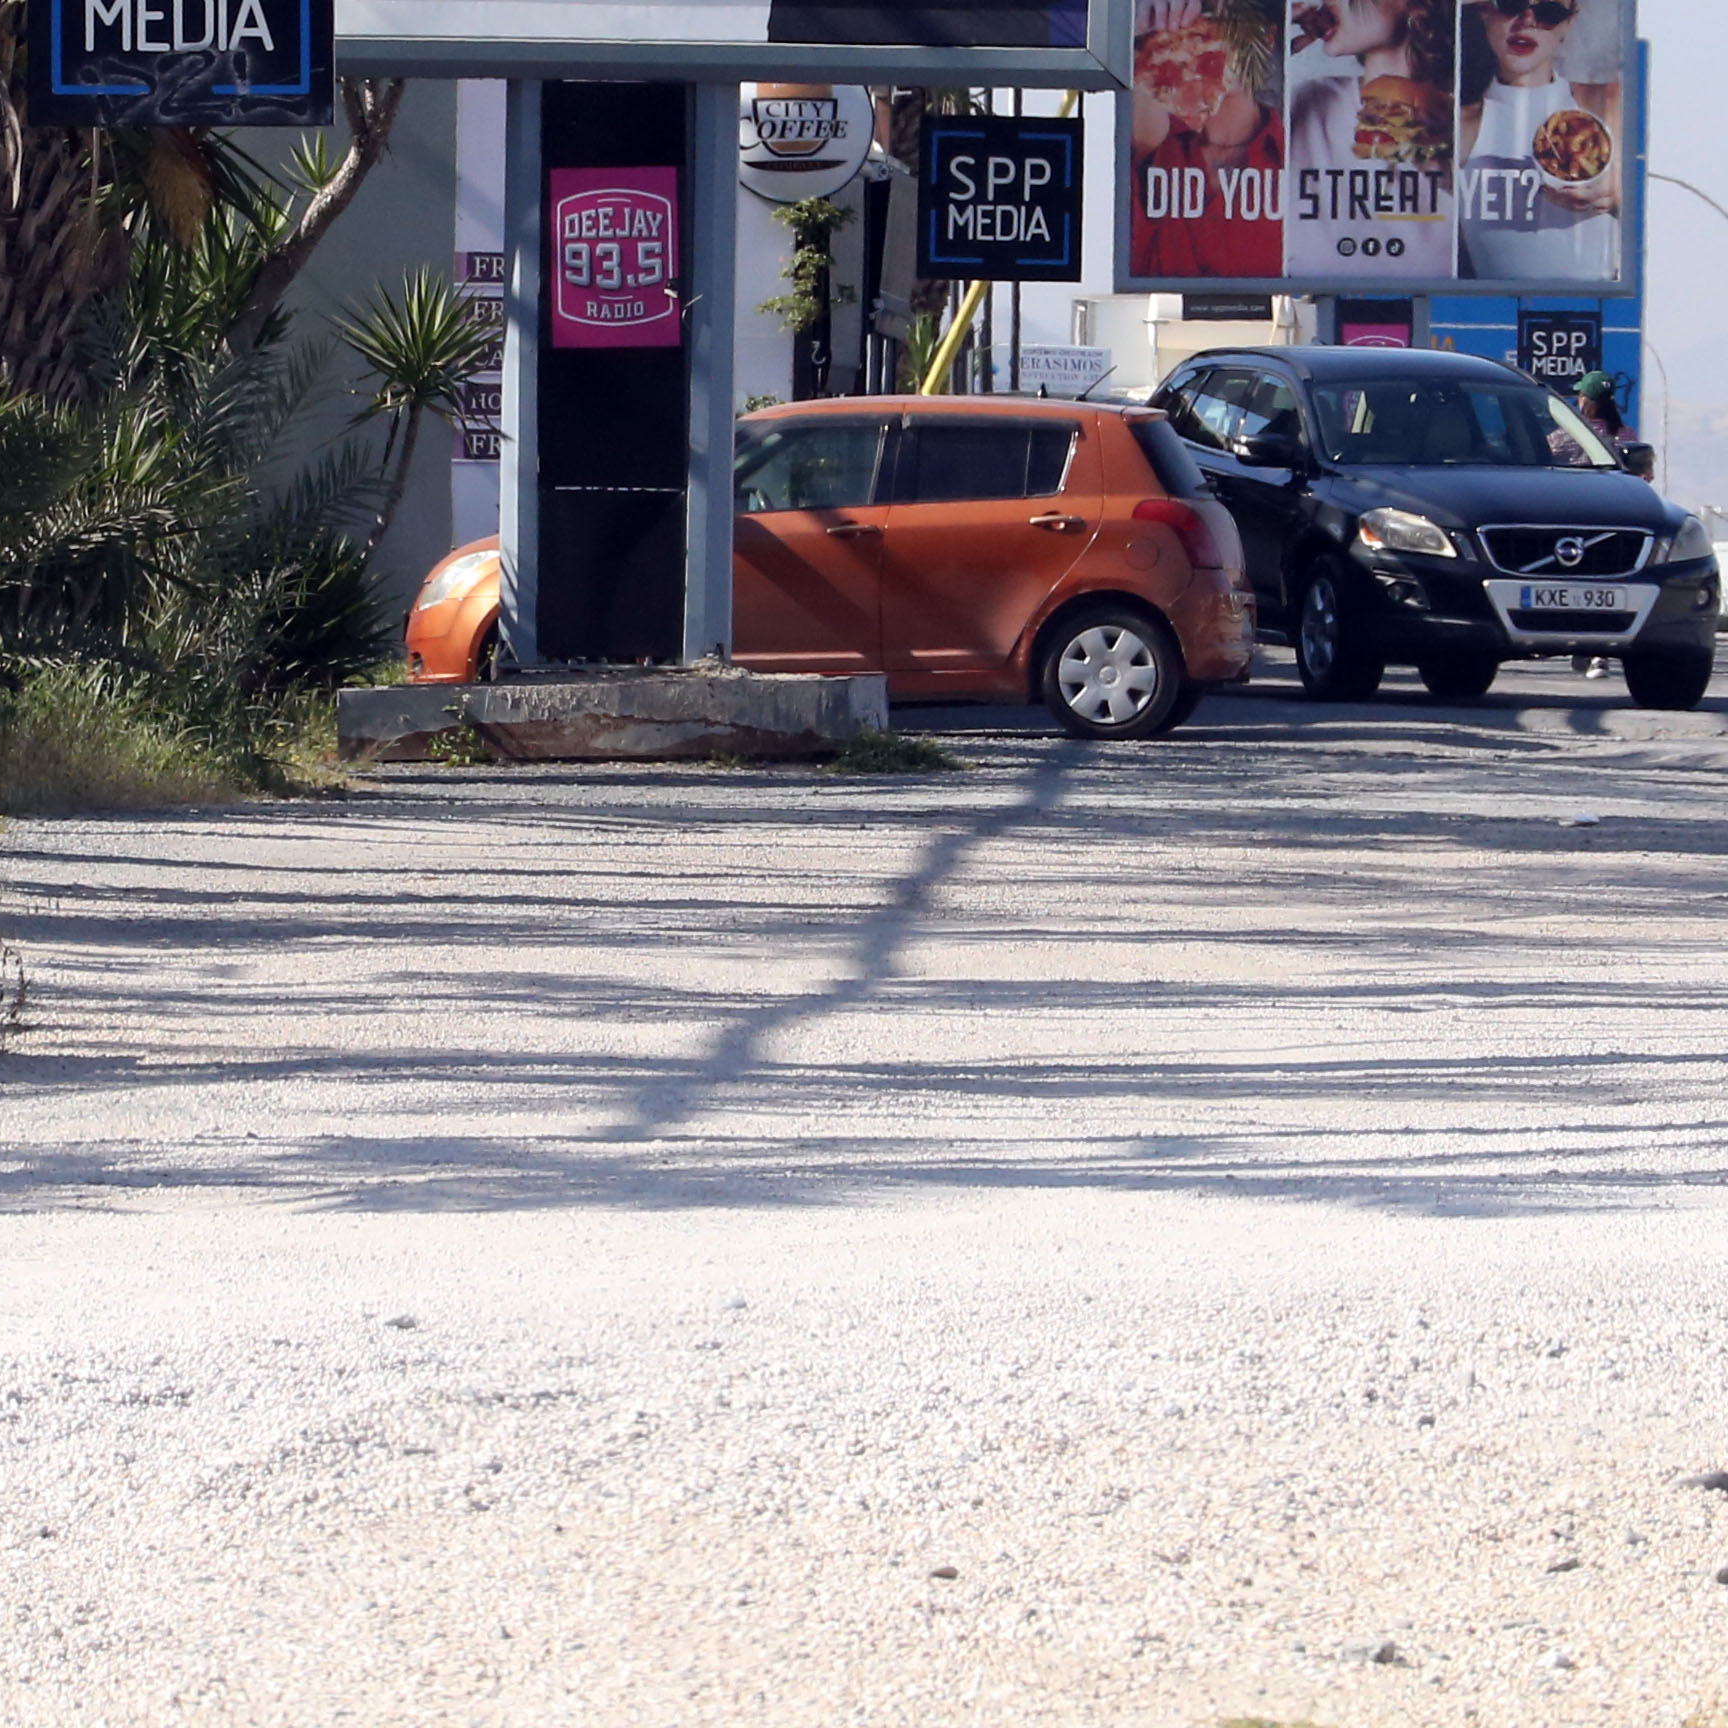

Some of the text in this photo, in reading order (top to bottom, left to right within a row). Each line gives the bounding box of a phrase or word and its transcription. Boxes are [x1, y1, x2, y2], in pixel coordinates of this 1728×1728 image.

[765, 102, 825, 118] CITY
[948, 155, 1052, 202] SPP
[1146, 167, 1542, 222] DID YOU STREAT YET?
[564, 207, 664, 240] DEEJAY
[947, 204, 1051, 243] MEDIA
[473, 255, 504, 278] FR
[564, 241, 664, 291] 93.5
[472, 300, 504, 322] FR
[585, 300, 645, 319] RADIO
[1532, 330, 1588, 356] SPP
[1020, 356, 1103, 371] ERASIMOS
[1531, 356, 1587, 376] MEDIA
[471, 391, 502, 410] HO
[471, 433, 501, 456] FR
[1535, 589, 1615, 608] KXE 930
